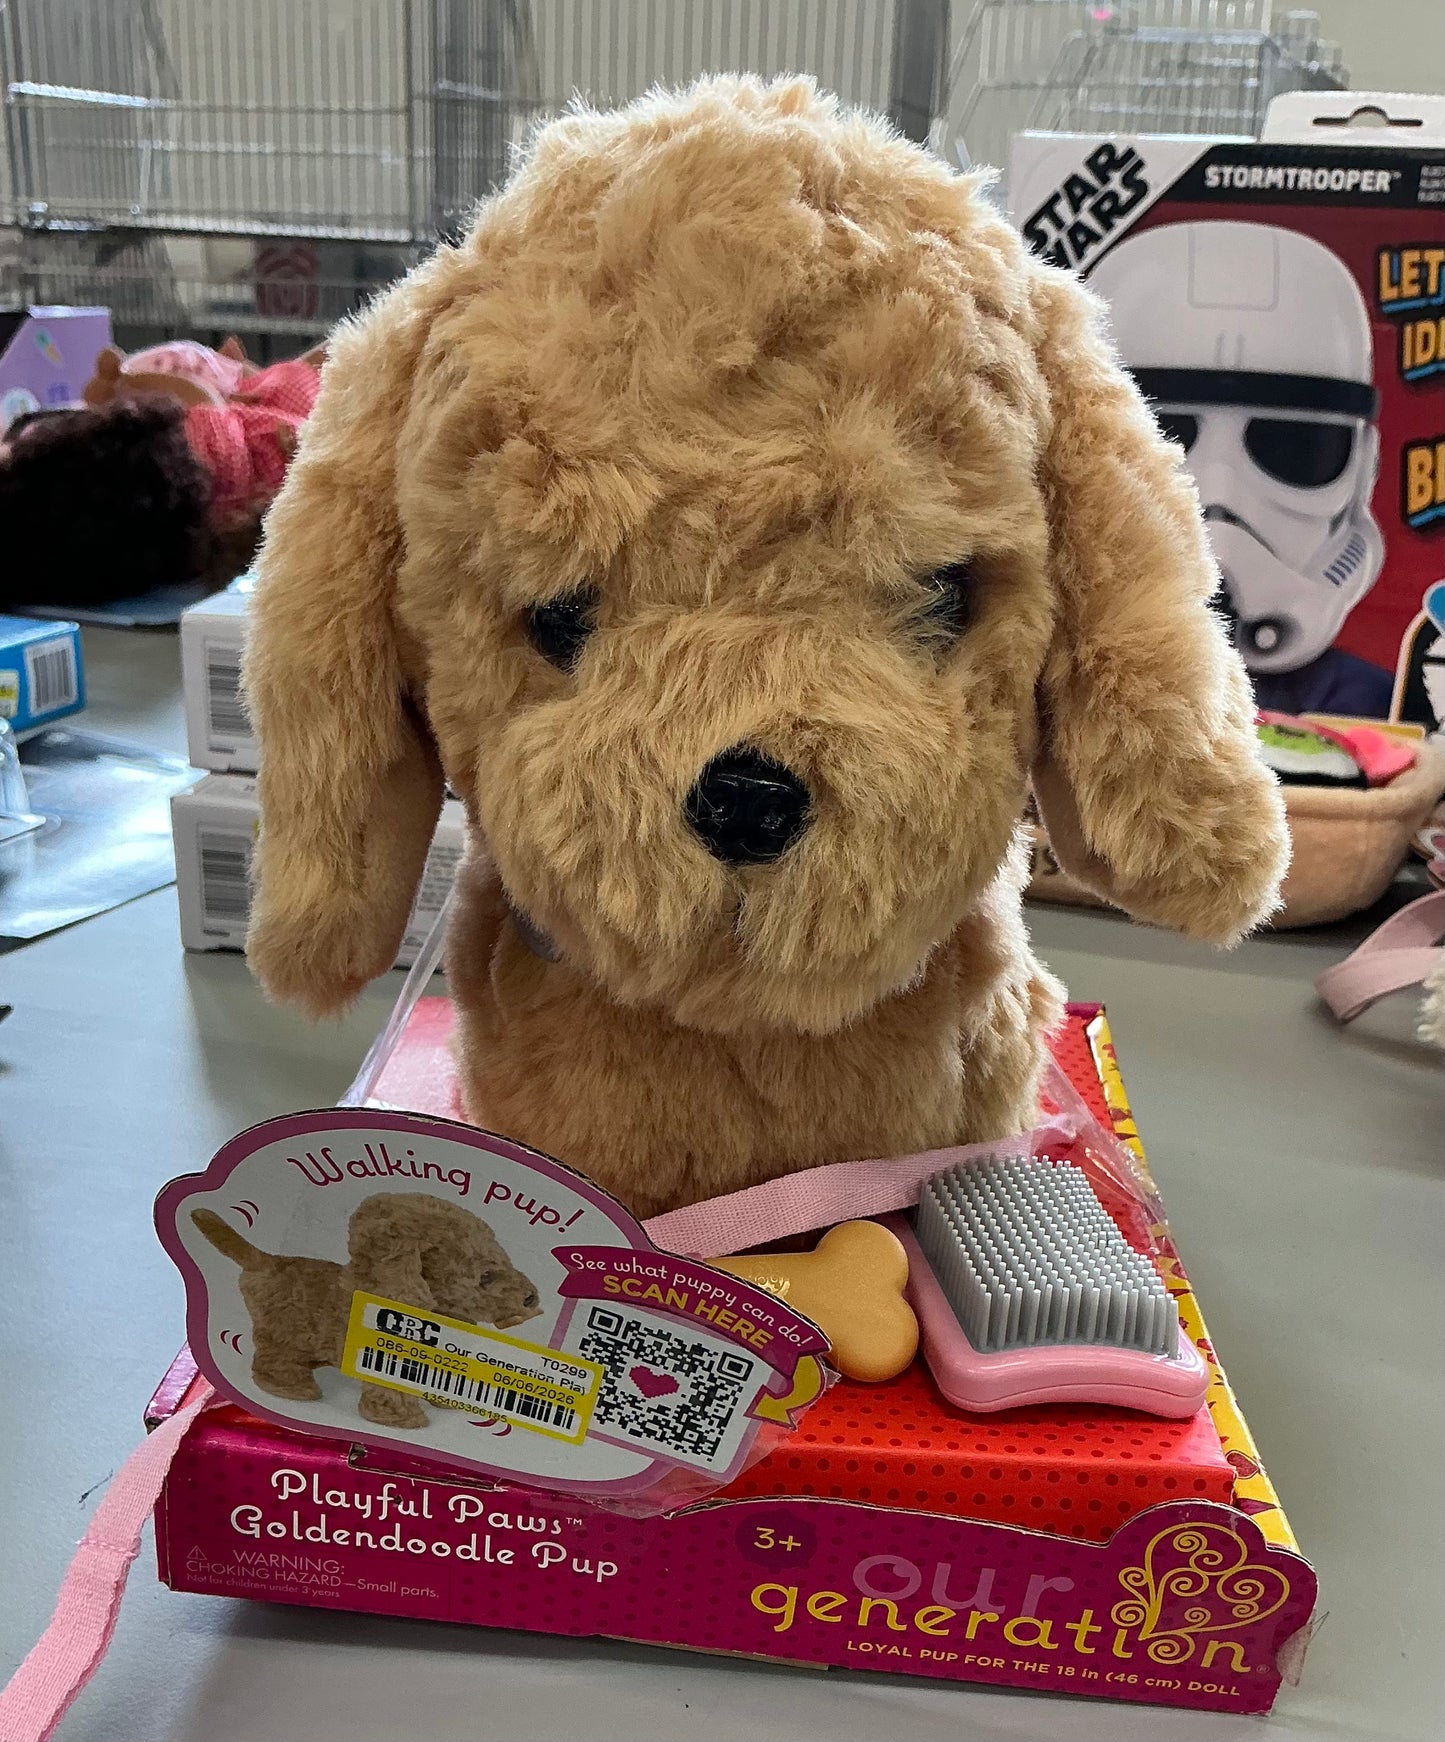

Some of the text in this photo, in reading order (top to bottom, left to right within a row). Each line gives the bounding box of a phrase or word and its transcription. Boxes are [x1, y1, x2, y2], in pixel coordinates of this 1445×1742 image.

[1023, 142, 1136, 255] STAR
[287, 1143, 585, 1234] Walking pup!
[569, 1252, 813, 1348] See what puppy can do!
[602, 1274, 775, 1350] SCAN HERE
[376, 1308, 441, 1348] CRC
[444, 1342, 472, 1358] Our
[475, 1352, 556, 1385] Generation
[541, 1356, 588, 1379] T0299
[493, 1371, 576, 1406] 06/06/2026
[271, 1468, 432, 1521] Playful
[230, 1505, 619, 1583] Goldendoodle Pup
[232, 1549, 346, 1576] WARNING:
[753, 1526, 802, 1553] 3+
[185, 1560, 270, 1580] CHOKING
[186, 1574, 207, 1584] Not
[226, 1578, 267, 1591] children
[269, 1584, 299, 1594] under
[312, 1588, 340, 1598] years
[852, 1554, 1075, 1621] our
[846, 1640, 1241, 1697] LOYAL PUP FOR THE 18 in (46 cm) DOLL
